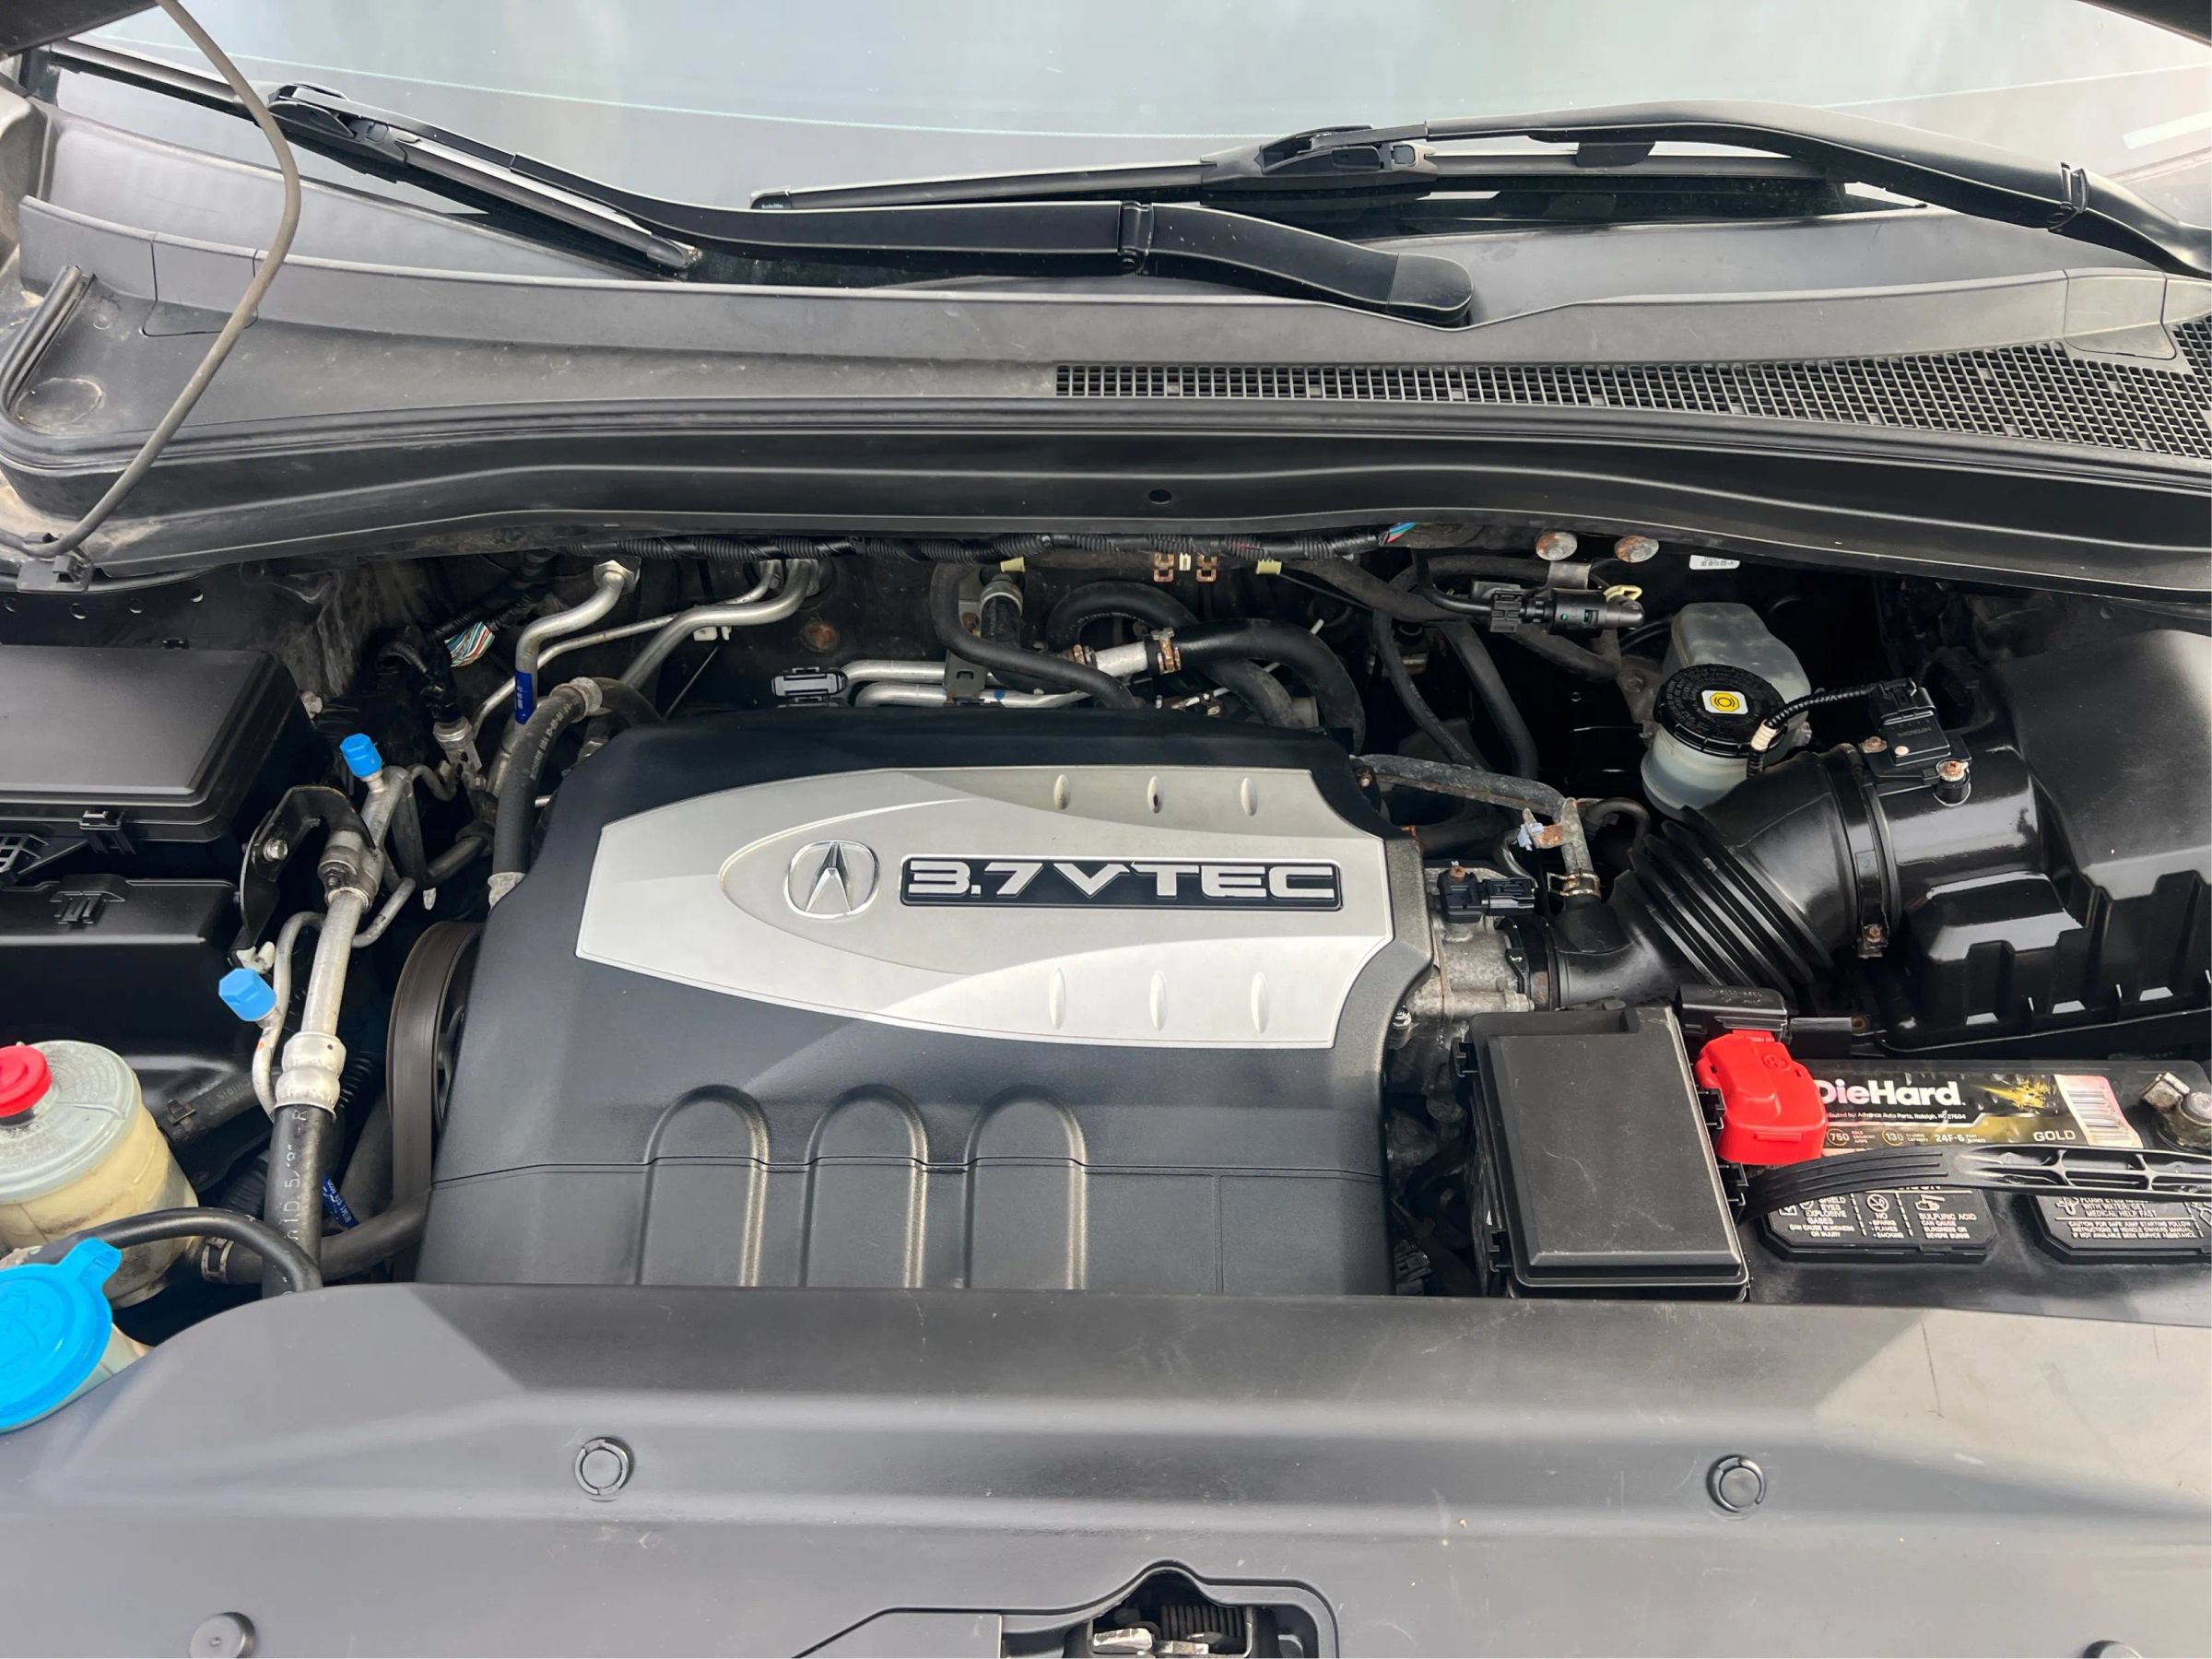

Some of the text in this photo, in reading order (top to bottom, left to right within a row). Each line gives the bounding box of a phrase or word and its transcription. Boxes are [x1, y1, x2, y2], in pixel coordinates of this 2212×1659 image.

[1830, 1133, 1850, 1142] 750
[1885, 1133, 1904, 1142] 130
[2033, 1130, 2076, 1142] GOLD
